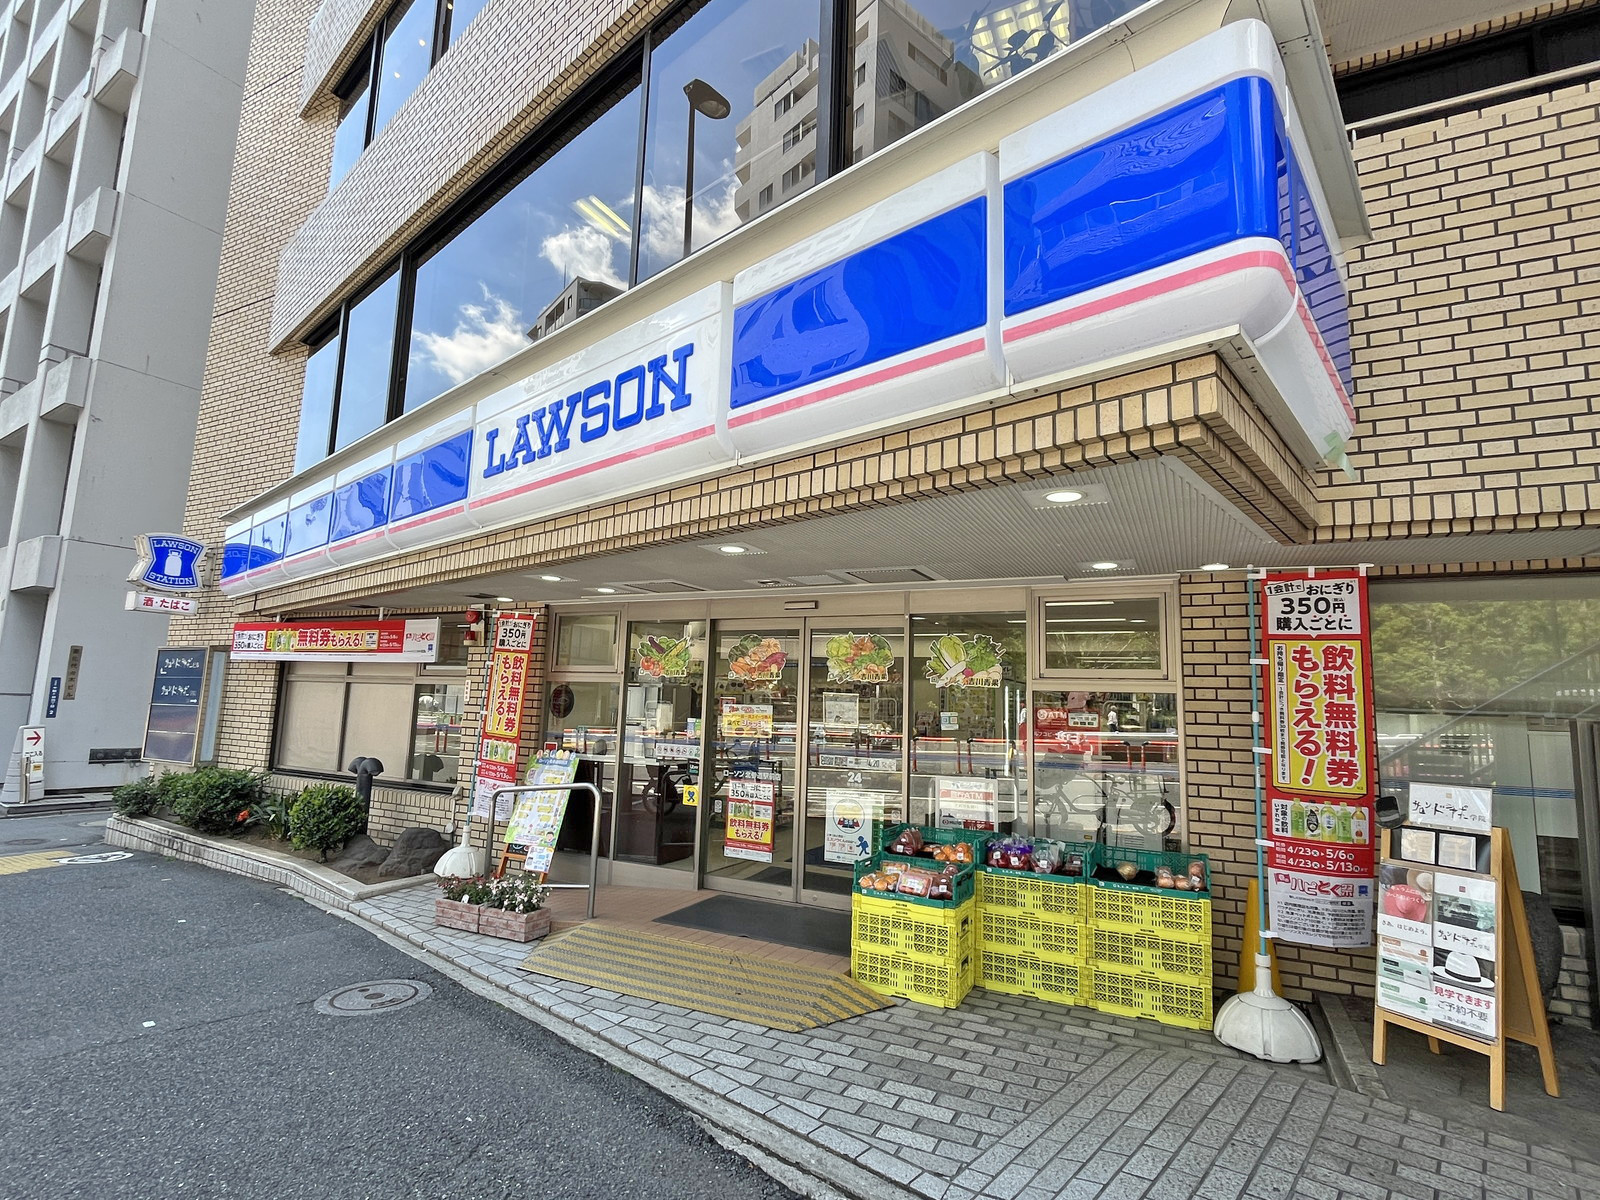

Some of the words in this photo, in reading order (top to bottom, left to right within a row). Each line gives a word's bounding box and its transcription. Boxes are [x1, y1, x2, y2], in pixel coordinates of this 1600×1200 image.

[483, 343, 694, 479] LAWSON
[153, 540, 198, 554] LAWSON
[148, 571, 193, 585] STATION
[1267, 583, 1302, 595] 1会計で
[1306, 582, 1355, 595] おにぎり
[143, 596, 190, 611] 酒・たばこ
[1280, 597, 1346, 615] 350円
[1276, 616, 1353, 632] 購入ごとに
[501, 628, 527, 639] 350円
[495, 655, 511, 731] もらえる!
[504, 655, 525, 732] 飲料無料券
[1047, 711, 1067, 719] ATM
[1291, 645, 1323, 786] もらえる!
[1321, 645, 1360, 787] 飲料無料券
[847, 771, 863, 783] 24
[729, 817, 769, 831] 飲料無料券
[1434, 985, 1493, 1010] 見学できます
[1437, 1000, 1489, 1023] ご予約不要
